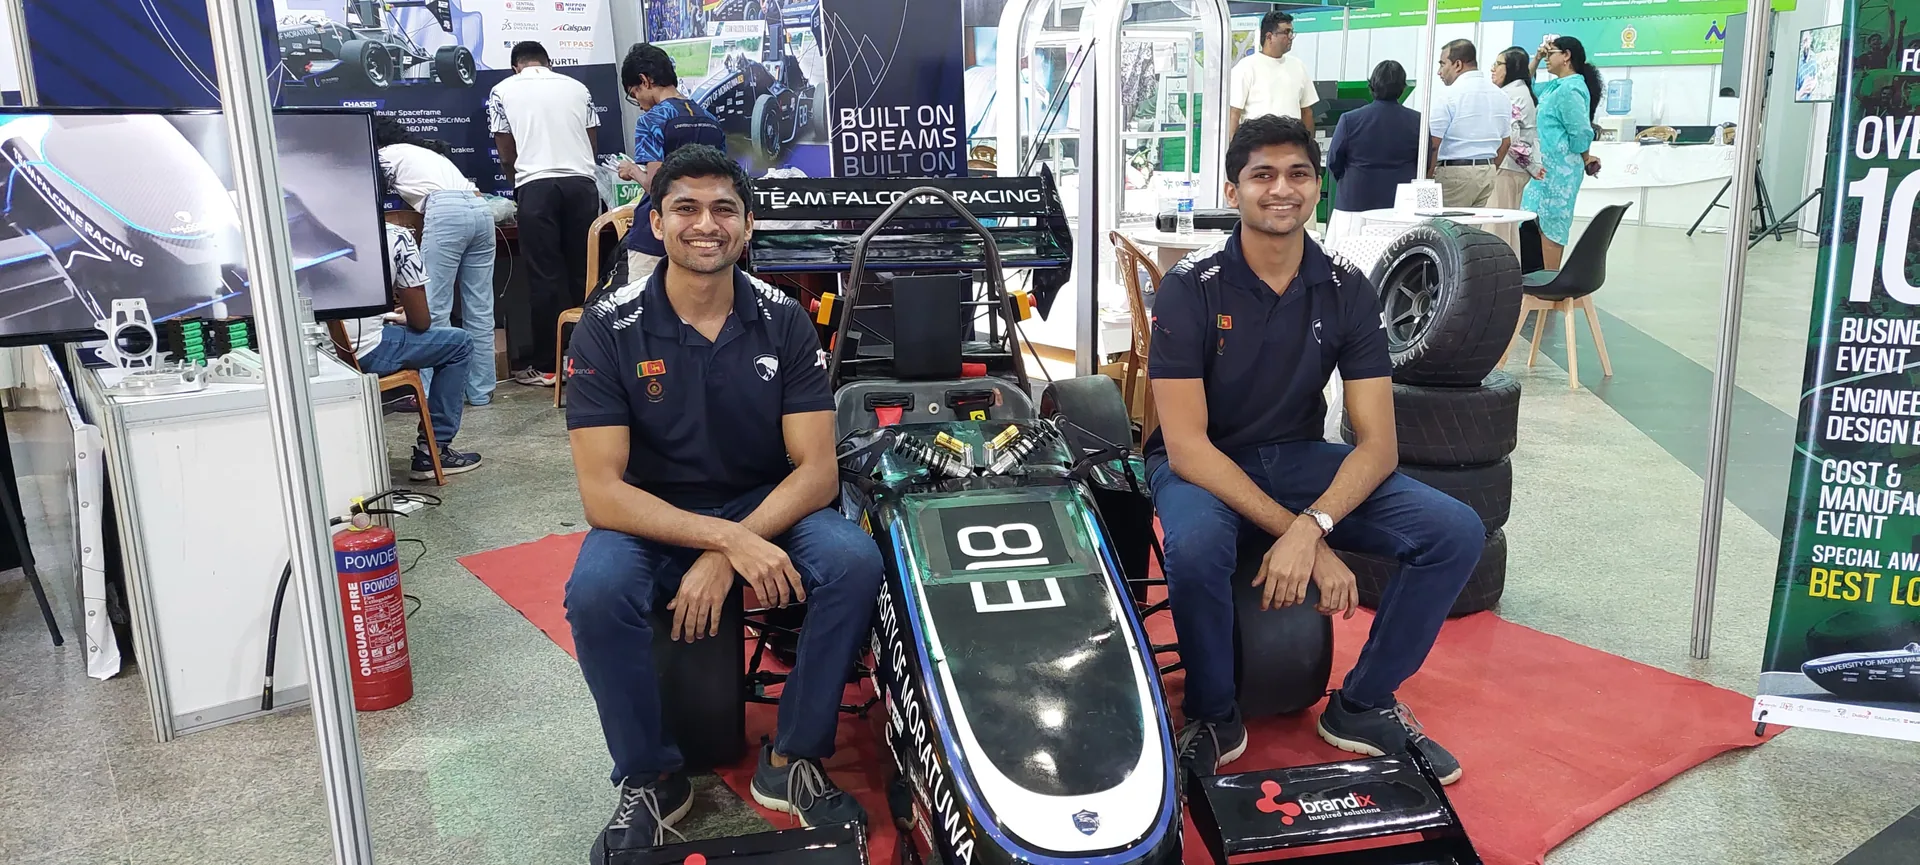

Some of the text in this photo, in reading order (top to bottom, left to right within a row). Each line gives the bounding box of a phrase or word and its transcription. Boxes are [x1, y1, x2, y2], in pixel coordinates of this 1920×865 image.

[283, 27, 317, 39] MORATUWA
[563, 24, 592, 32] Calspan
[398, 109, 441, 117] Spaceframe
[840, 104, 954, 129] BUILT ON
[841, 127, 957, 153] DREAMS
[843, 151, 956, 177] BUILT ON
[13, 148, 144, 268] TEAM FALCONE RACING
[754, 190, 827, 206] TEAM
[954, 188, 1041, 204] RACING
[1836, 346, 1911, 374] EVENT
[1826, 416, 1909, 445] DESIGN
[1821, 458, 1902, 488] COST &
[1816, 510, 1888, 540] EVENT
[1812, 544, 1920, 572] SPECIAL AW
[364, 573, 398, 594] POWDER
[1808, 567, 1882, 603] BEST
[348, 582, 372, 677] ONGUARD FIRE
[1817, 661, 1864, 674] UNIVERSITY
[1876, 657, 1916, 665] MORATUWA
[893, 640, 906, 682] OF
[900, 673, 977, 865] MORATUWA
[1298, 792, 1376, 814] brandix
[1308, 807, 1381, 821] inspired solutions
